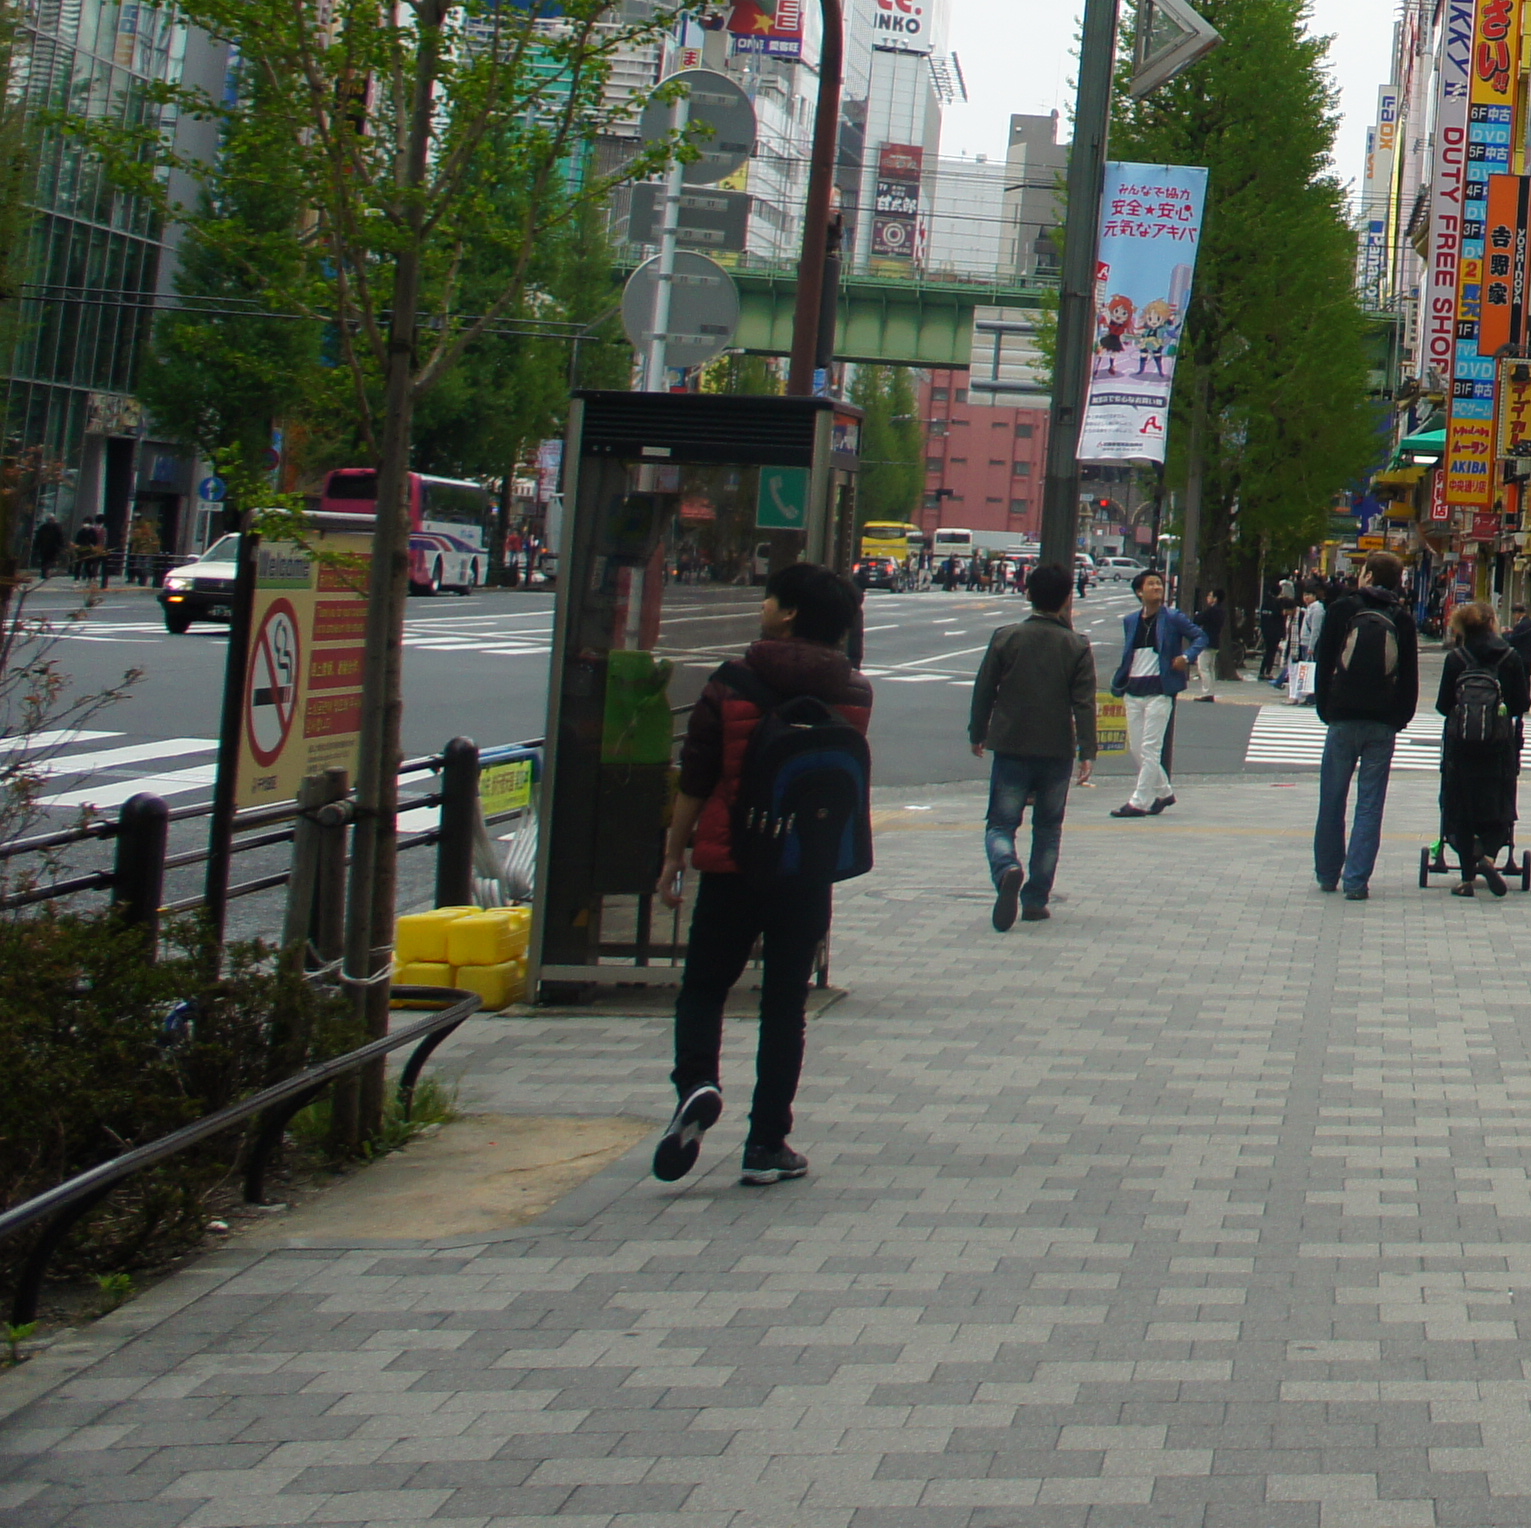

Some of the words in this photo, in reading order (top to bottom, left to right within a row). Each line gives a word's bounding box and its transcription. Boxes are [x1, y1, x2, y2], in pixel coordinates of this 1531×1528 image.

[1470, 106, 1488, 120] 6F
[1488, 107, 1511, 122] 中古
[1471, 128, 1508, 143] DVD
[1468, 145, 1485, 159] 5F
[1485, 147, 1509, 161] 中古
[1440, 126, 1465, 203] DUTY
[1117, 183, 1191, 202] みんなで協力
[1466, 184, 1482, 197] 4F
[1103, 219, 1198, 243] 元気なアキバ
[1463, 223, 1480, 236] 3F
[1434, 215, 1459, 287] FREE
[1487, 224, 1513, 306] 吉野家
[1458, 323, 1473, 336] 1F
[1456, 362, 1493, 378] DVD
[1453, 382, 1473, 395] B1F
[1474, 383, 1493, 397] 中古
[1453, 401, 1493, 417] PCゲーム
[1452, 440, 1489, 455] ムーラン
[1451, 459, 1489, 475] AKIBA
[1449, 479, 1488, 495] 中央通り店
